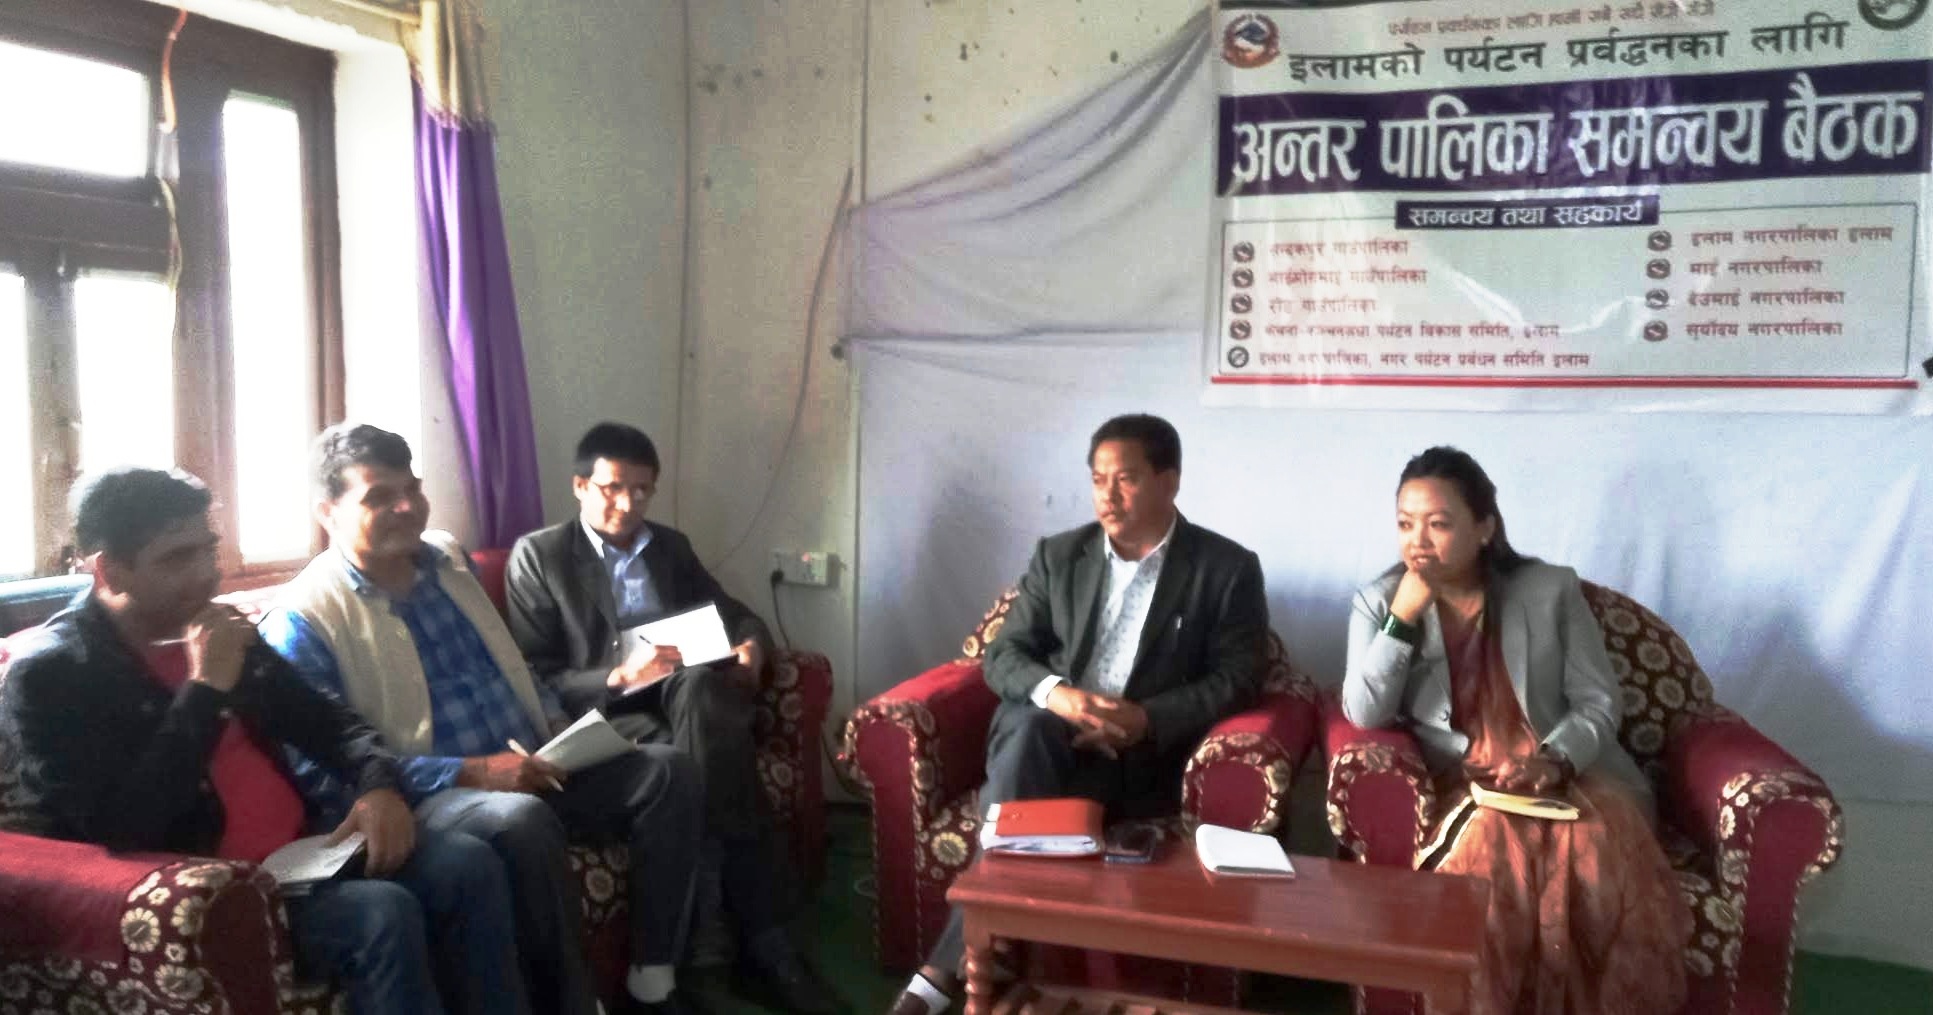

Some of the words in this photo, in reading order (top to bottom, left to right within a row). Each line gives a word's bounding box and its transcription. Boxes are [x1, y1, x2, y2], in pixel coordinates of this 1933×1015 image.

[1288, 42, 1425, 83] इलामको
[1444, 37, 1546, 73] पर्यटन
[1750, 12, 1850, 54] लागि
[1232, 119, 1367, 183] अन्तर
[1378, 94, 1554, 181] पालिका
[1568, 100, 1769, 178] समन्वय
[1782, 71, 1924, 162] बैठक
[1408, 208, 1495, 226] समन्वय
[1501, 207, 1547, 225] तथा
[1691, 232, 1734, 247] इलाम
[1743, 225, 1838, 243] नगरपालिका
[1728, 256, 1823, 275] नगरपालिका
[1750, 287, 1844, 305] नगरपालिका
[1748, 317, 1843, 336] नगरपालिका
